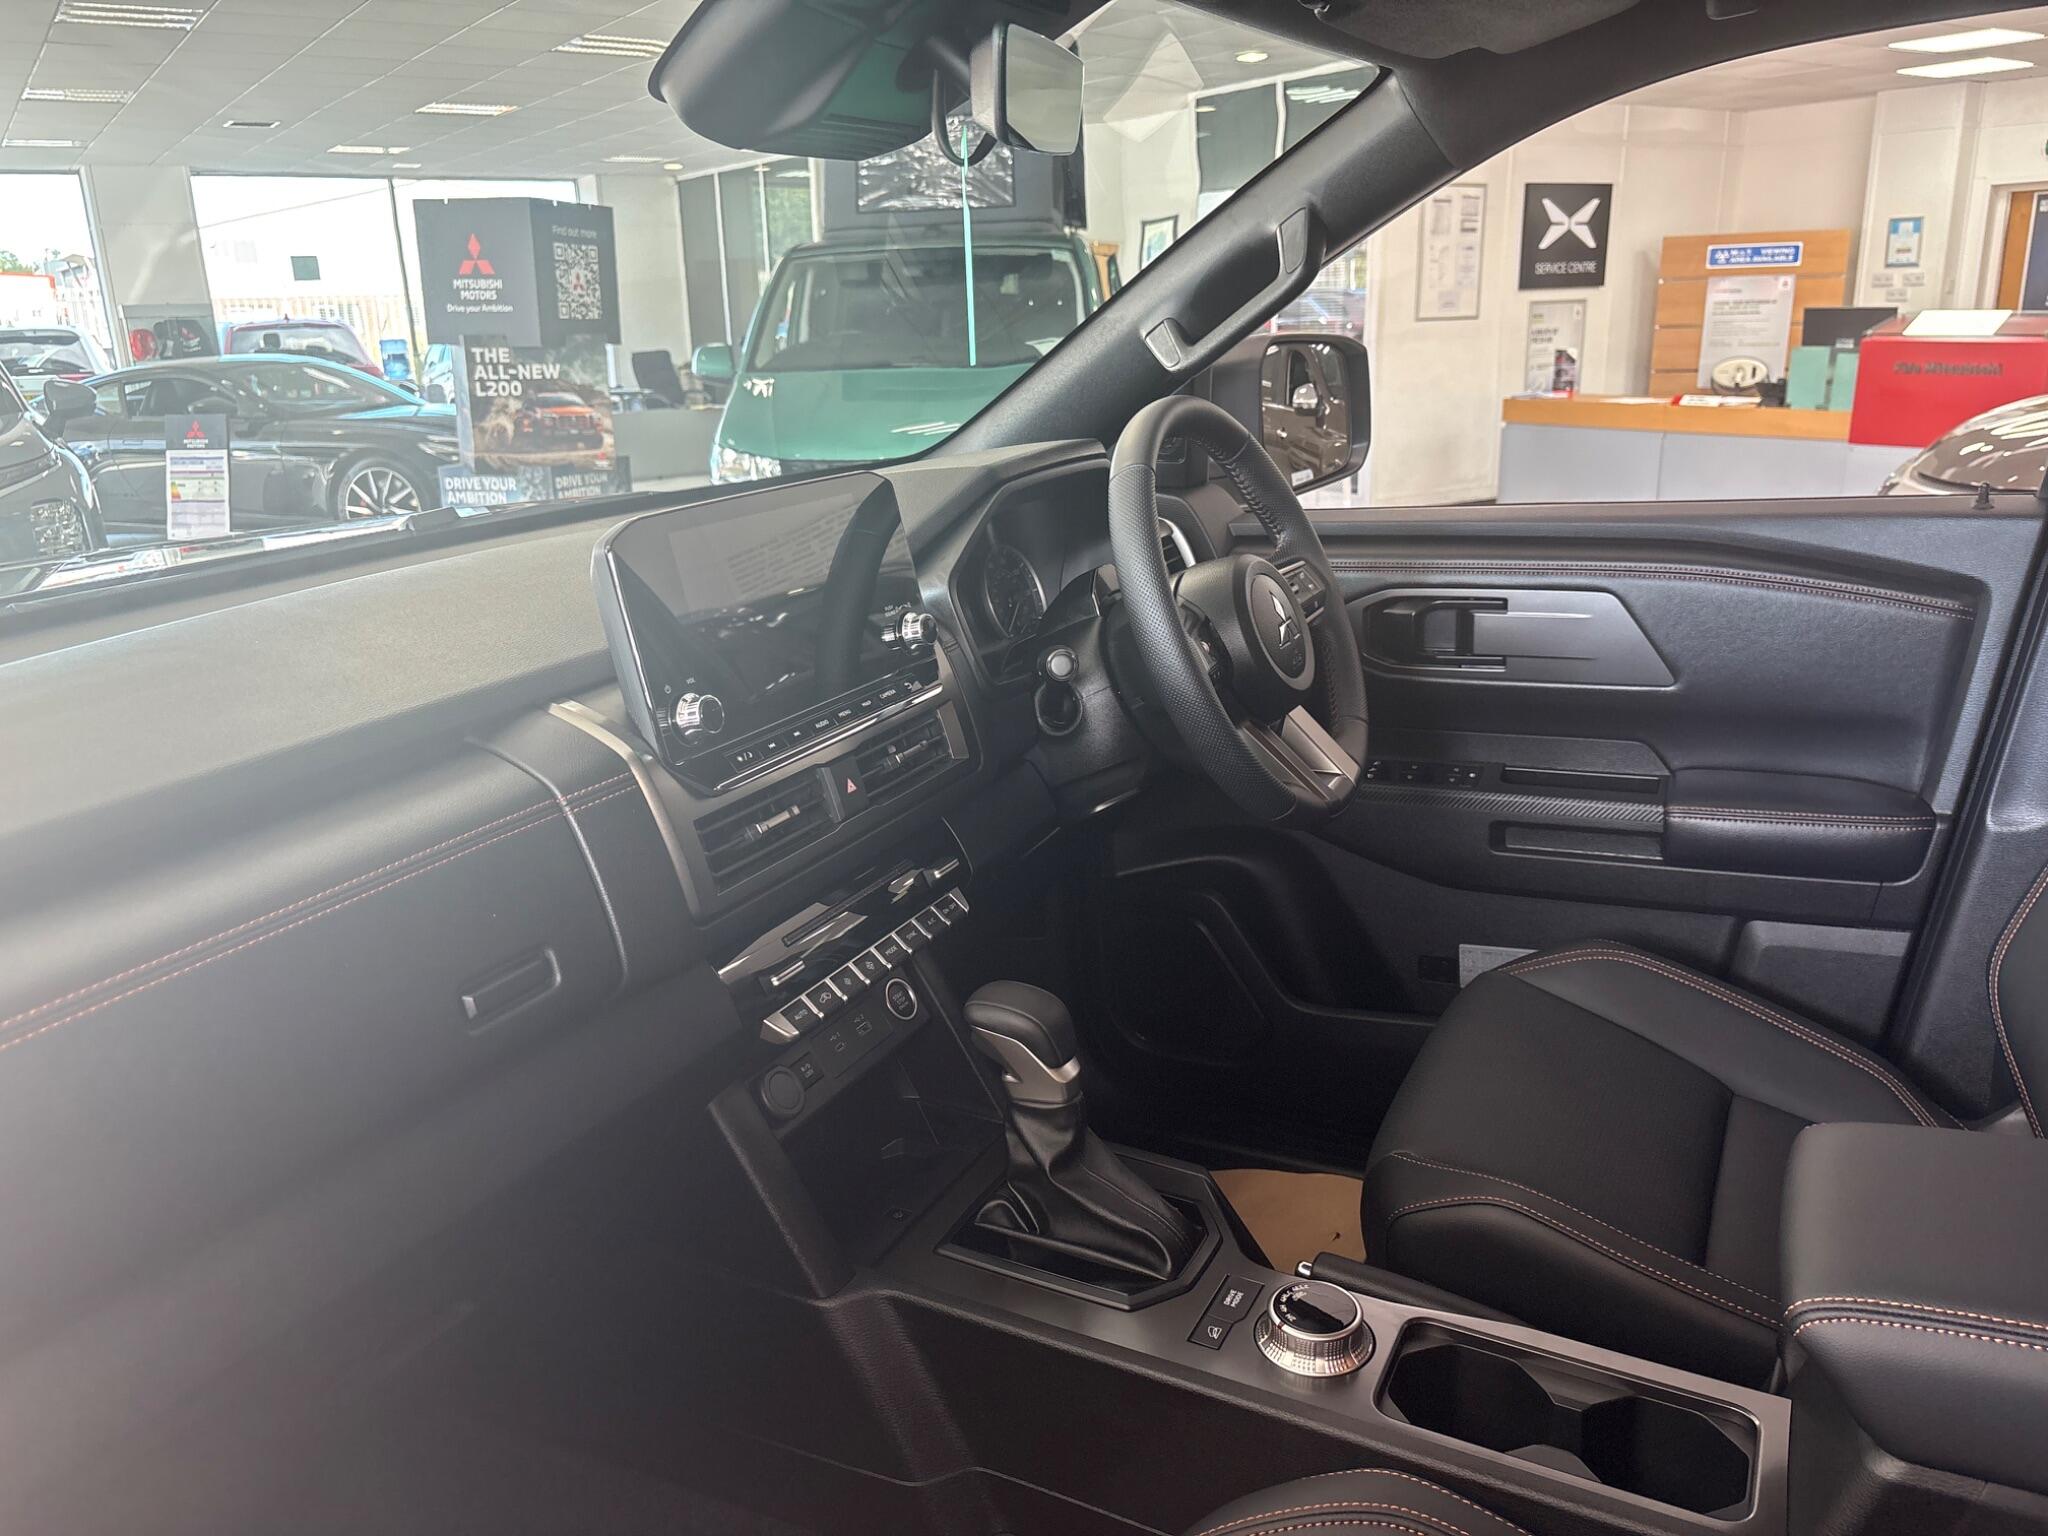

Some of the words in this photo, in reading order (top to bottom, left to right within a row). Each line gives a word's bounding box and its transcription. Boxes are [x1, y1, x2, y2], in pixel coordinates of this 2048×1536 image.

[567, 228, 579, 237] out
[580, 230, 597, 240] more
[1535, 262, 1567, 275] SERVICE
[1568, 261, 1597, 274] CENTRE
[453, 279, 502, 290] MITSUBISHI
[461, 290, 497, 300] MOTORS
[447, 304, 465, 312] Drive
[465, 305, 481, 314] your
[481, 304, 513, 313] Ambition
[471, 347, 510, 363] THE
[474, 363, 561, 381] ALL-NEW
[475, 381, 522, 397] L200
[445, 477, 481, 491] DRIVE
[481, 477, 517, 491] YOUR
[555, 474, 582, 488] DRIVE
[584, 473, 608, 485] YOUR
[448, 491, 507, 504] AMBITION
[557, 487, 600, 499] AMBITION
[879, 689, 896, 699] CAMERA
[838, 709, 852, 718] MENU
[815, 719, 830, 728] AUDIO
[885, 946, 899, 956] MODE
[794, 1009, 808, 1020] AUTO
[1223, 1289, 1237, 1306] DRIVE
[1230, 1291, 1244, 1308] MODE
